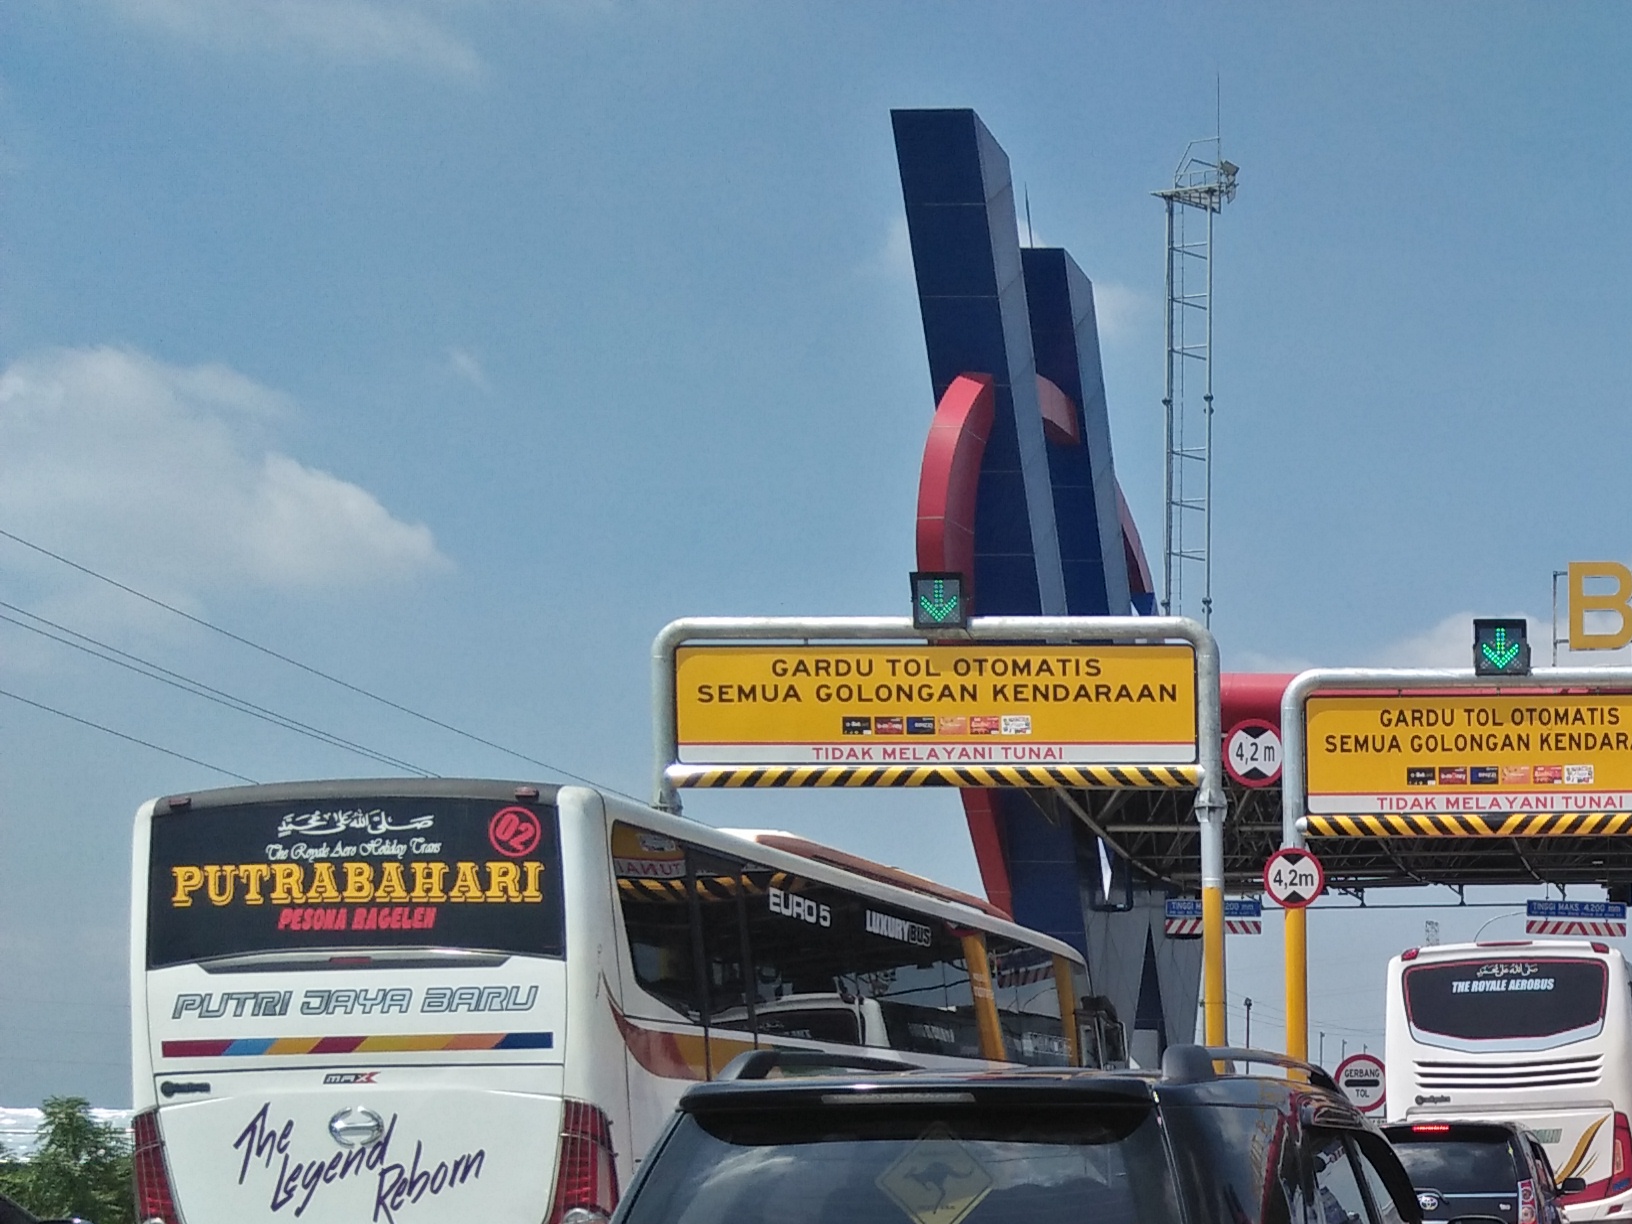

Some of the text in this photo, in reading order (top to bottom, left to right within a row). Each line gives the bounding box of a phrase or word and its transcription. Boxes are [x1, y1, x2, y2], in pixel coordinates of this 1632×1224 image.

[771, 657, 1103, 678] GARDU TOL OTOMATIS
[696, 683, 1178, 704] SEMUA GOLONGAN KENDARAAN
[1380, 707, 1620, 728] GARDU TOL OTOMATIS
[812, 746, 1064, 761] TIDAK MELAYANI TUNAI
[1235, 741, 1275, 766] 4,2 m
[1324, 733, 1402, 754] SEMUA
[1409, 733, 1530, 753] GOLONGAN
[1376, 795, 1624, 811] TIDAK MELAYANI TUNAI
[495, 813, 537, 851] 02
[265, 838, 442, 863] The Royale Aero Holiday Trans
[171, 861, 545, 907] PUTRABAHARI
[1273, 868, 1315, 890] 4,2m
[768, 886, 831, 928] EURO 5
[1533, 902, 1556, 910] TINGGI
[277, 907, 437, 931] PESONA BAGELEN
[1452, 978, 1555, 993] THE ROYALE AEROBUS
[171, 985, 540, 1020] PUTRI JAYA BARU
[1344, 1068, 1380, 1078] GERBANG
[1355, 1088, 1370, 1098] TOL
[233, 1102, 294, 1185] The
[270, 1113, 398, 1218] Legend
